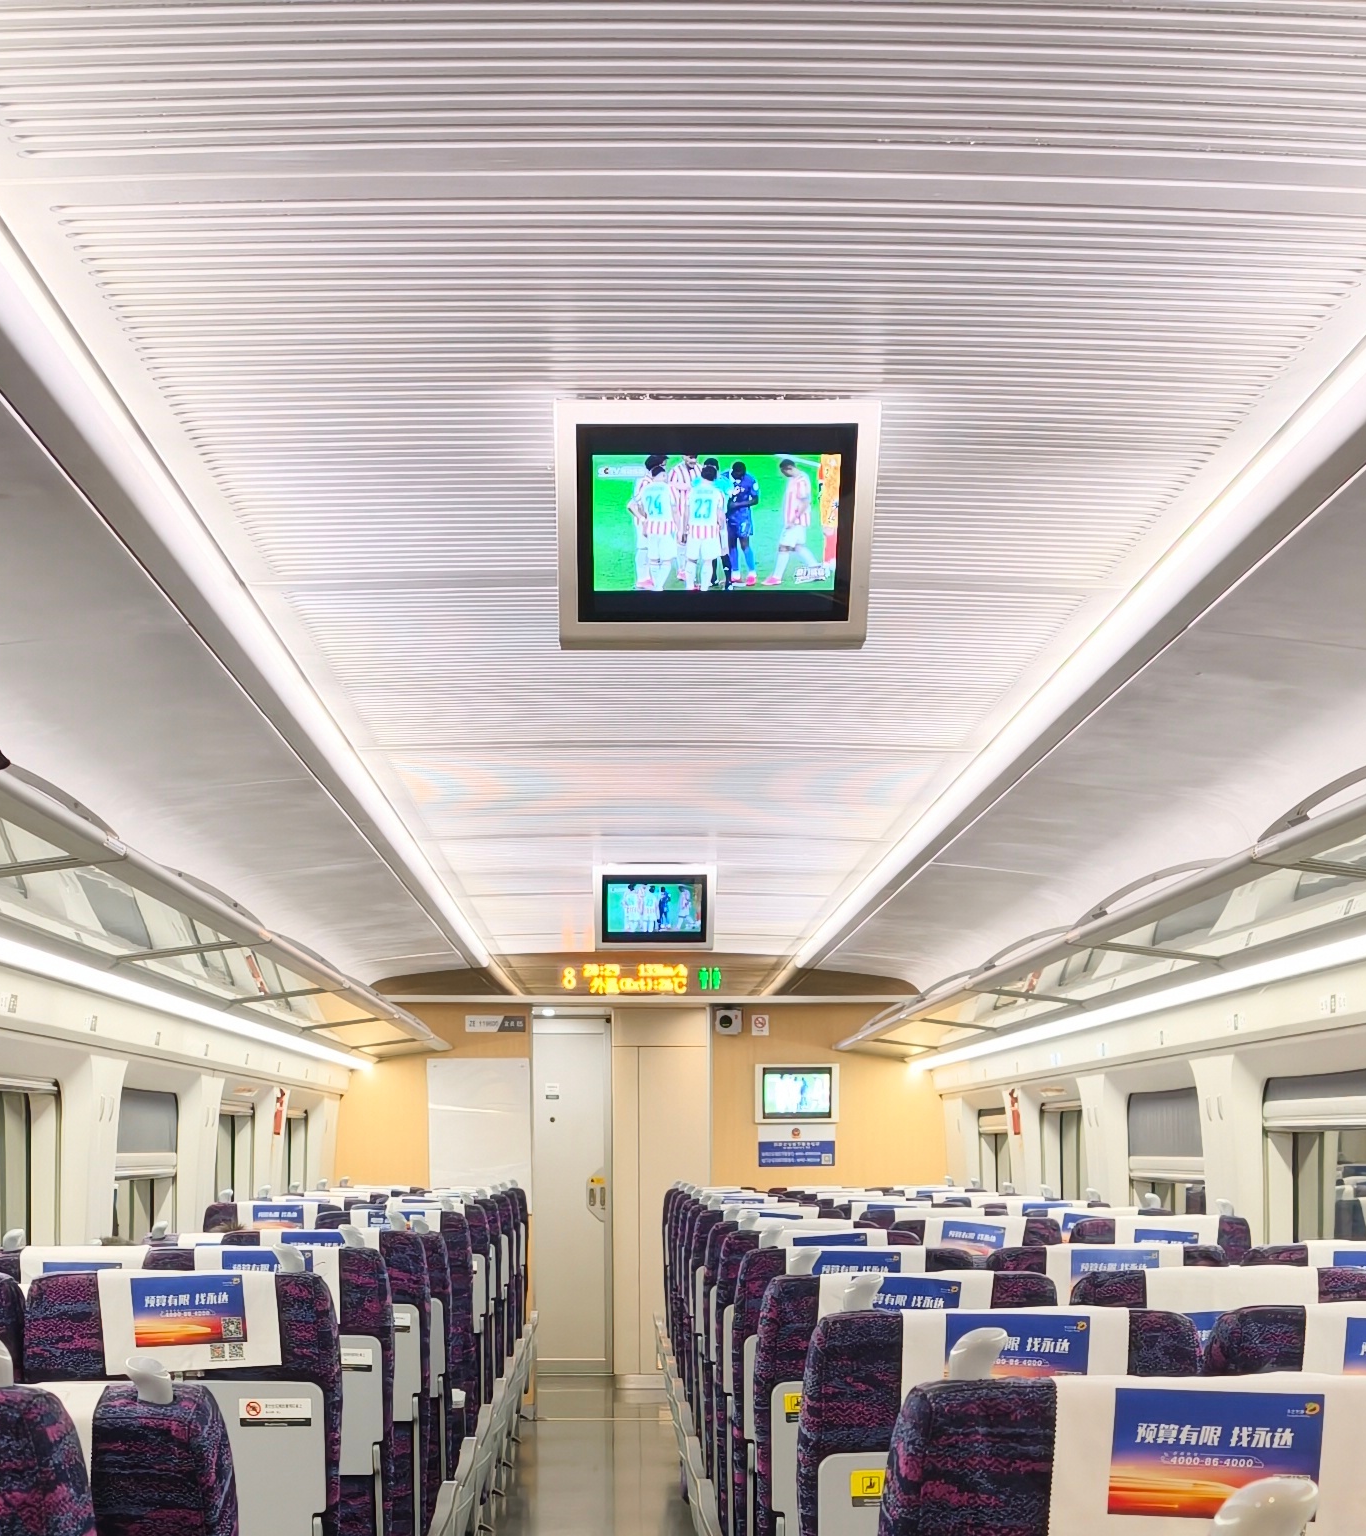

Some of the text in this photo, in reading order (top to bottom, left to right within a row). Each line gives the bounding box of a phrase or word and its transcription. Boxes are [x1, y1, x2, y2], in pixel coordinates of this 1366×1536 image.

[646, 494, 713, 520] 24 23
[562, 967, 577, 990] 8
[143, 1291, 229, 1307] 预算有限 找永达
[1026, 1336, 1070, 1354] 找永达
[1136, 1424, 1294, 1448] 预算有限 找永达
[1171, 1455, 1254, 1467] 4000-86-4000
